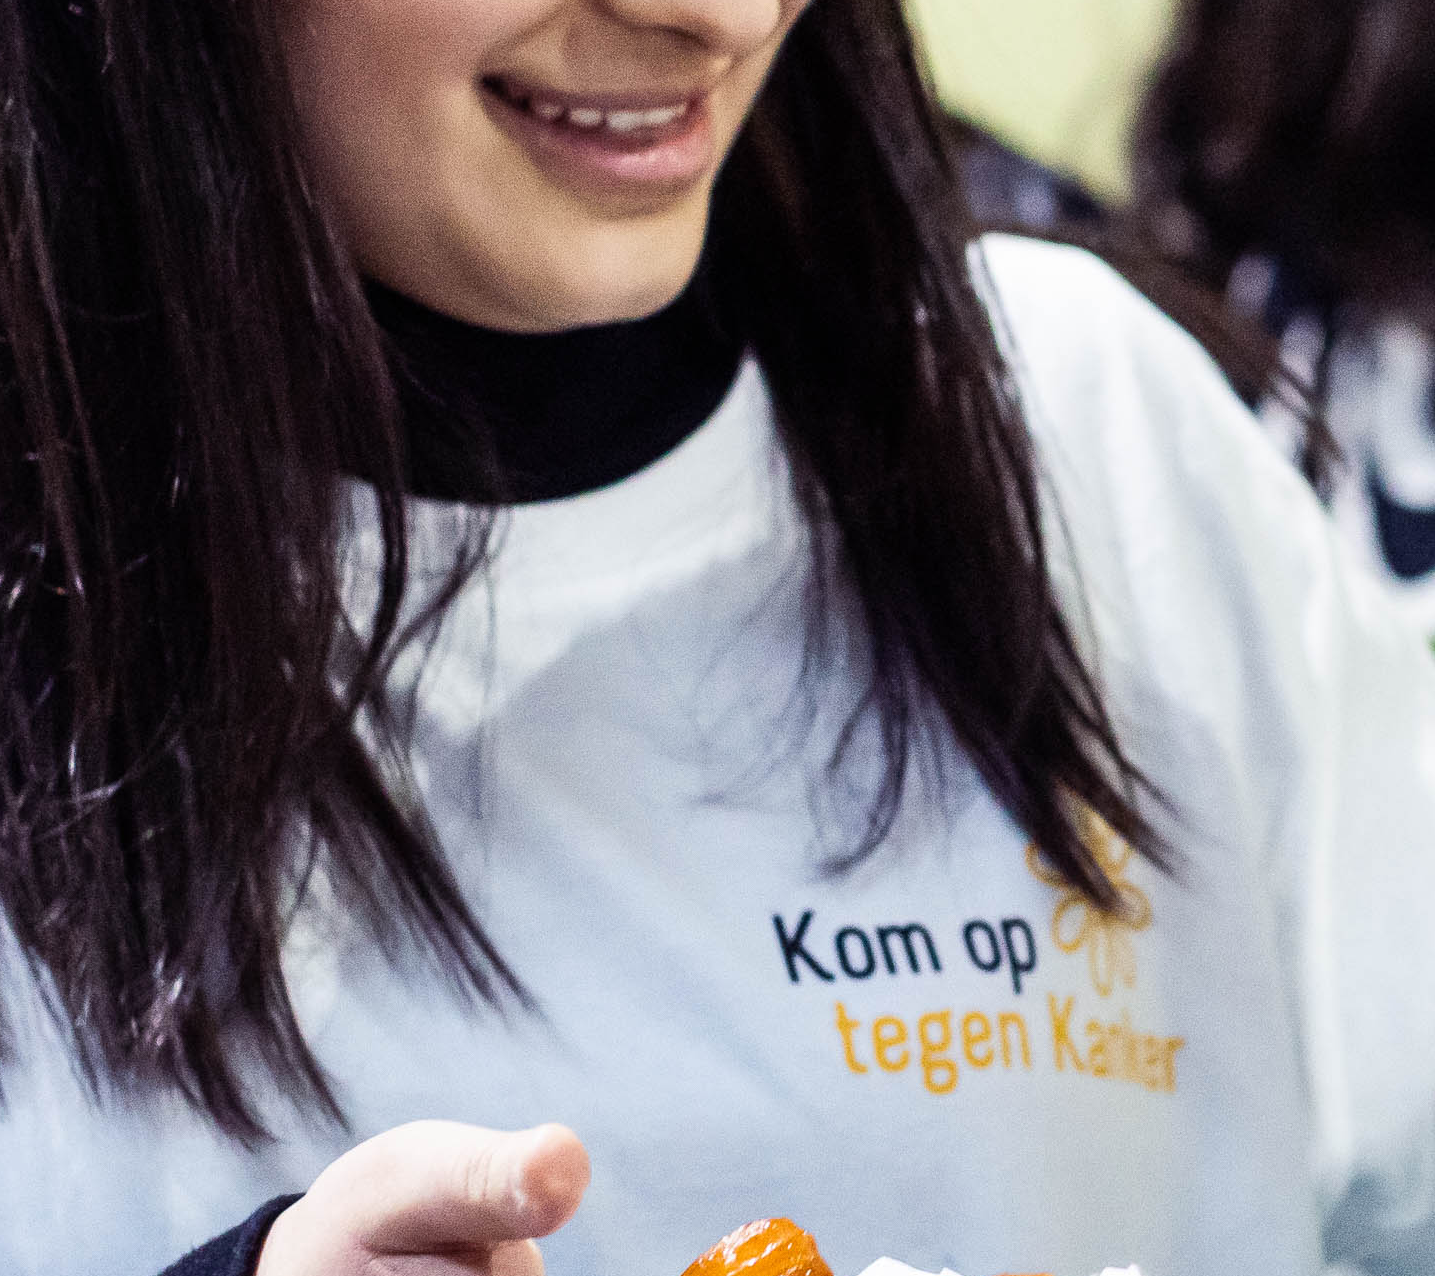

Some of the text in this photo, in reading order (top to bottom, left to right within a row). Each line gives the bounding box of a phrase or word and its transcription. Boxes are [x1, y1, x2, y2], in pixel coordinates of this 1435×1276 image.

[771, 907, 1039, 996] Kom op
[833, 999, 1033, 1096] tegen
